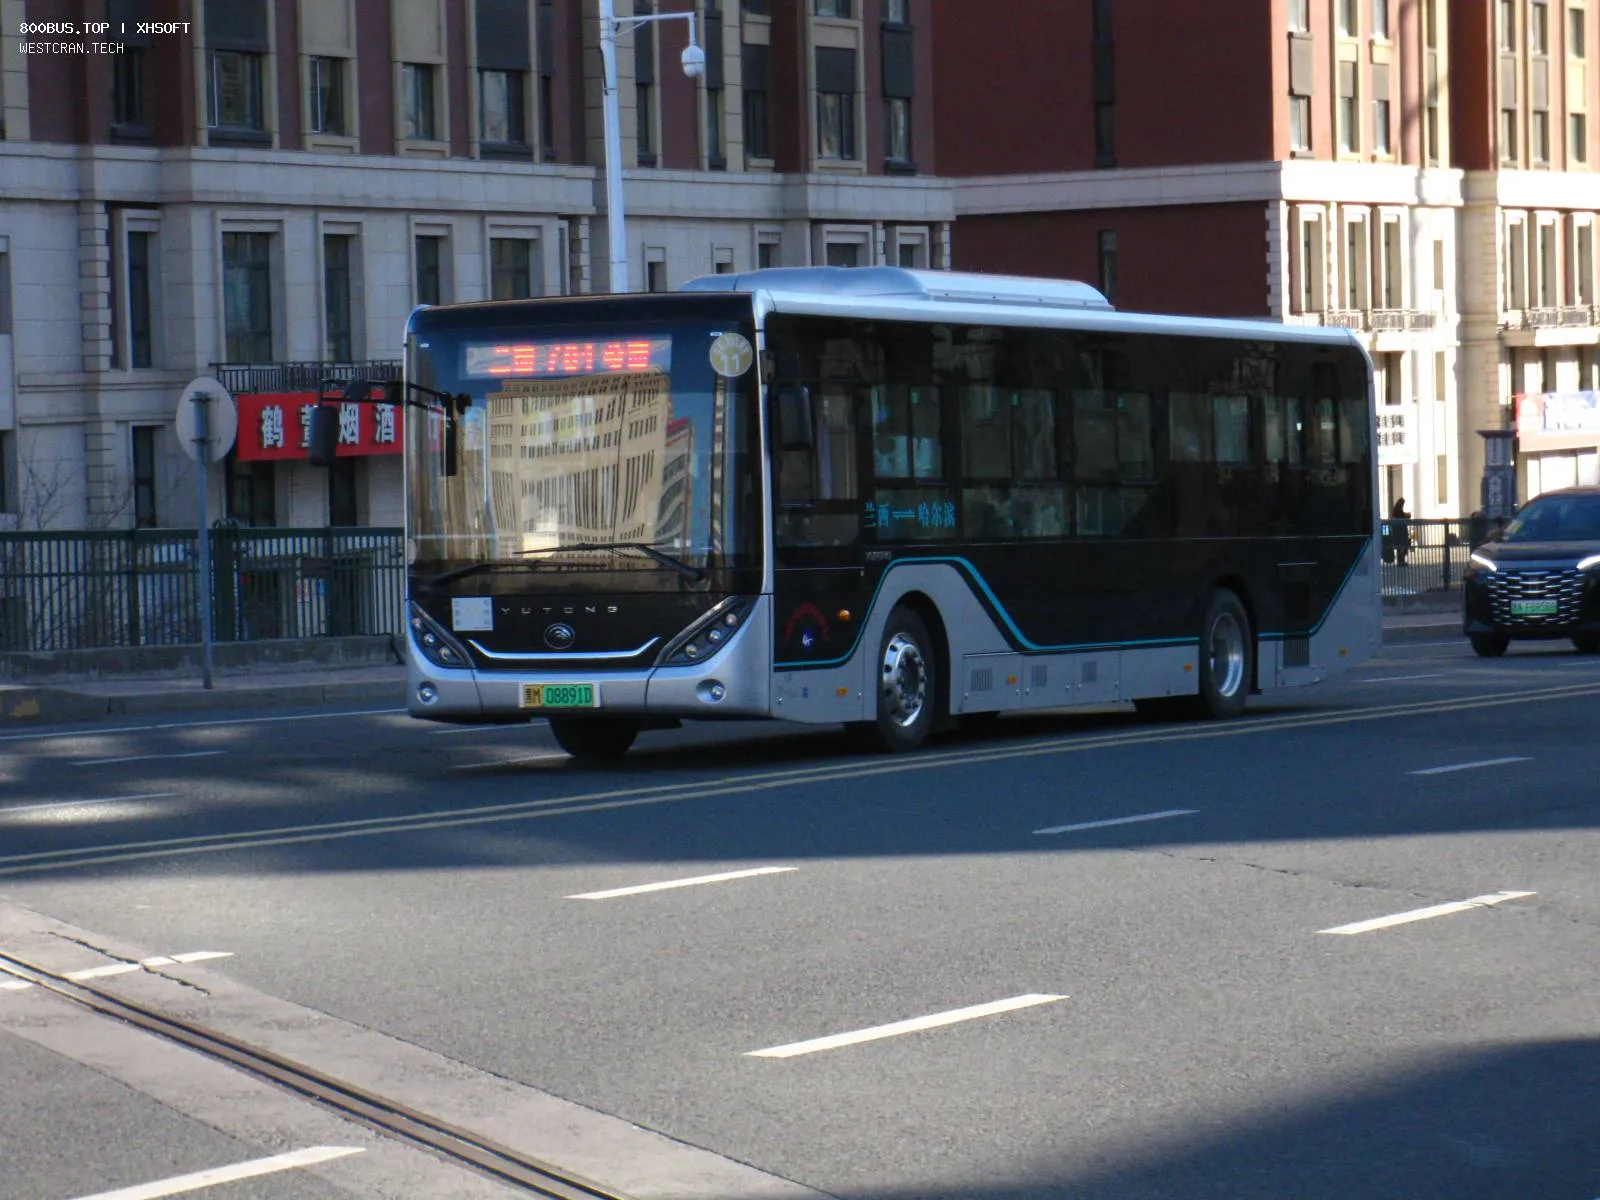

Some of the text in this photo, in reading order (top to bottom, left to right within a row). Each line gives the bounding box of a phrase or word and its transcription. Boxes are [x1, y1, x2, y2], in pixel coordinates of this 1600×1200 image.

[720, 352, 740, 375] 11
[918, 500, 956, 528] 哈尔滨
[500, 605, 618, 615] YUTONG
